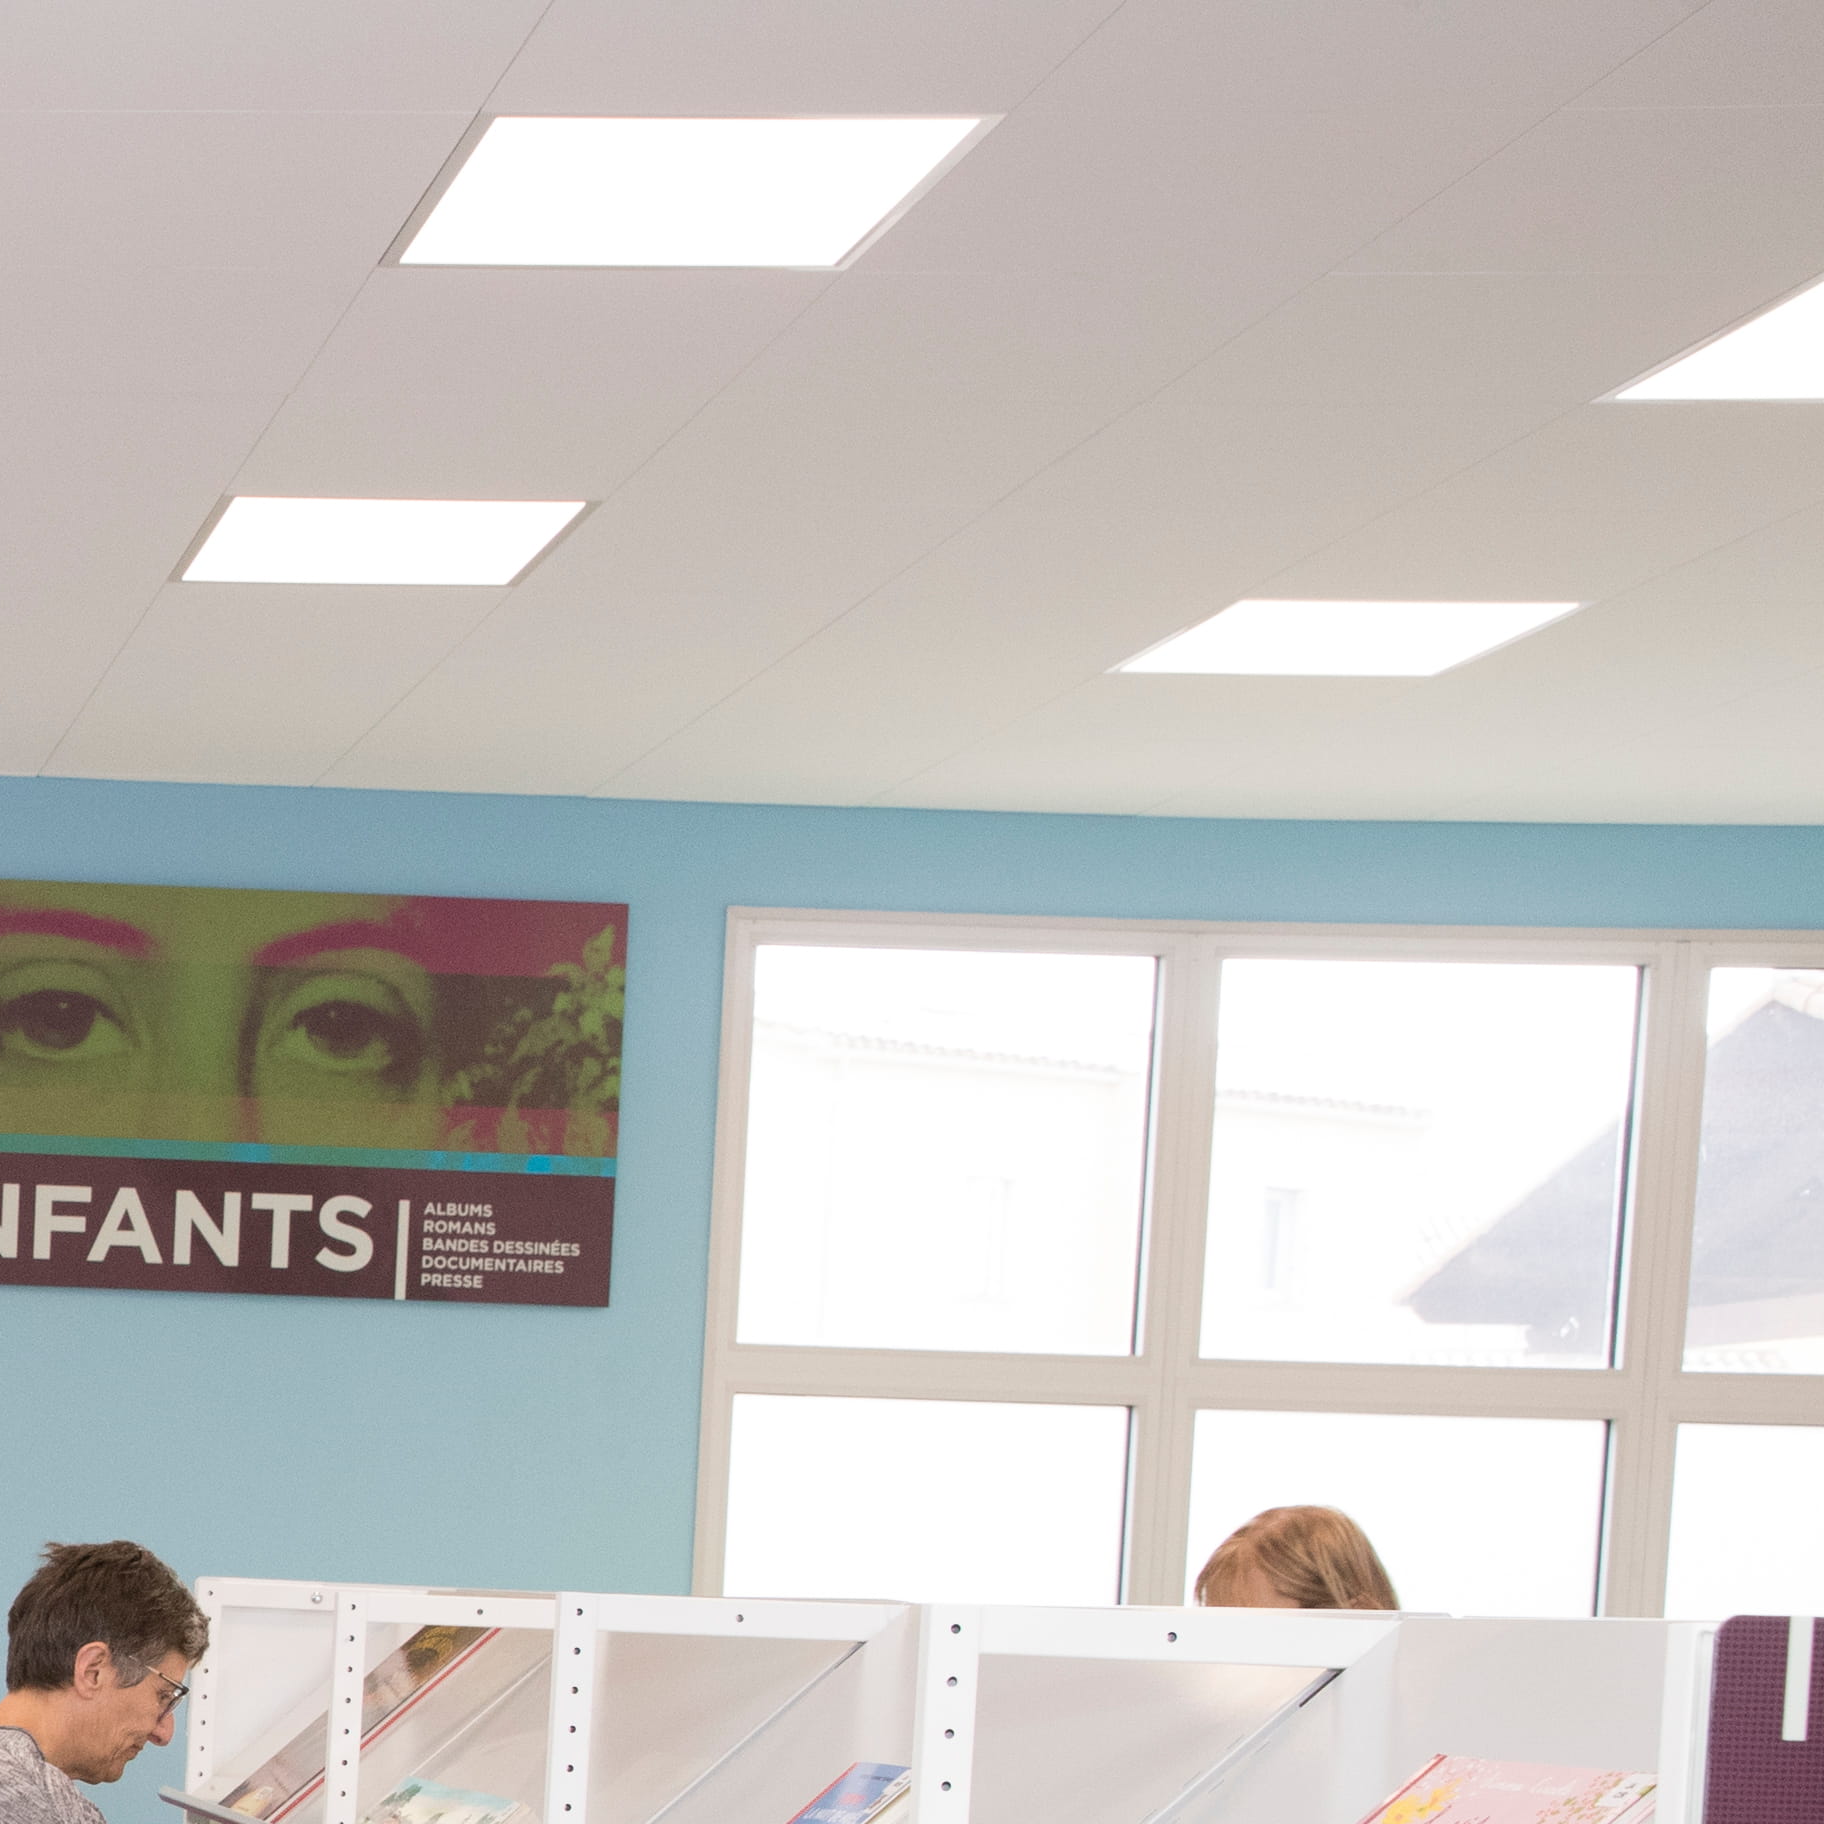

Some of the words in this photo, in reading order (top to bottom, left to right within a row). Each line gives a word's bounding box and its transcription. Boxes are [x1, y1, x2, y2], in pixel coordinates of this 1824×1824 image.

[423, 1202, 493, 1218] ALBUMS
[422, 1220, 496, 1236] ROMANS
[422, 1237, 489, 1253] BANDES
[493, 1240, 581, 1257] DESSINÉES
[421, 1256, 565, 1274] DOCUMENTAIRES
[420, 1273, 484, 1289] PRESSE
